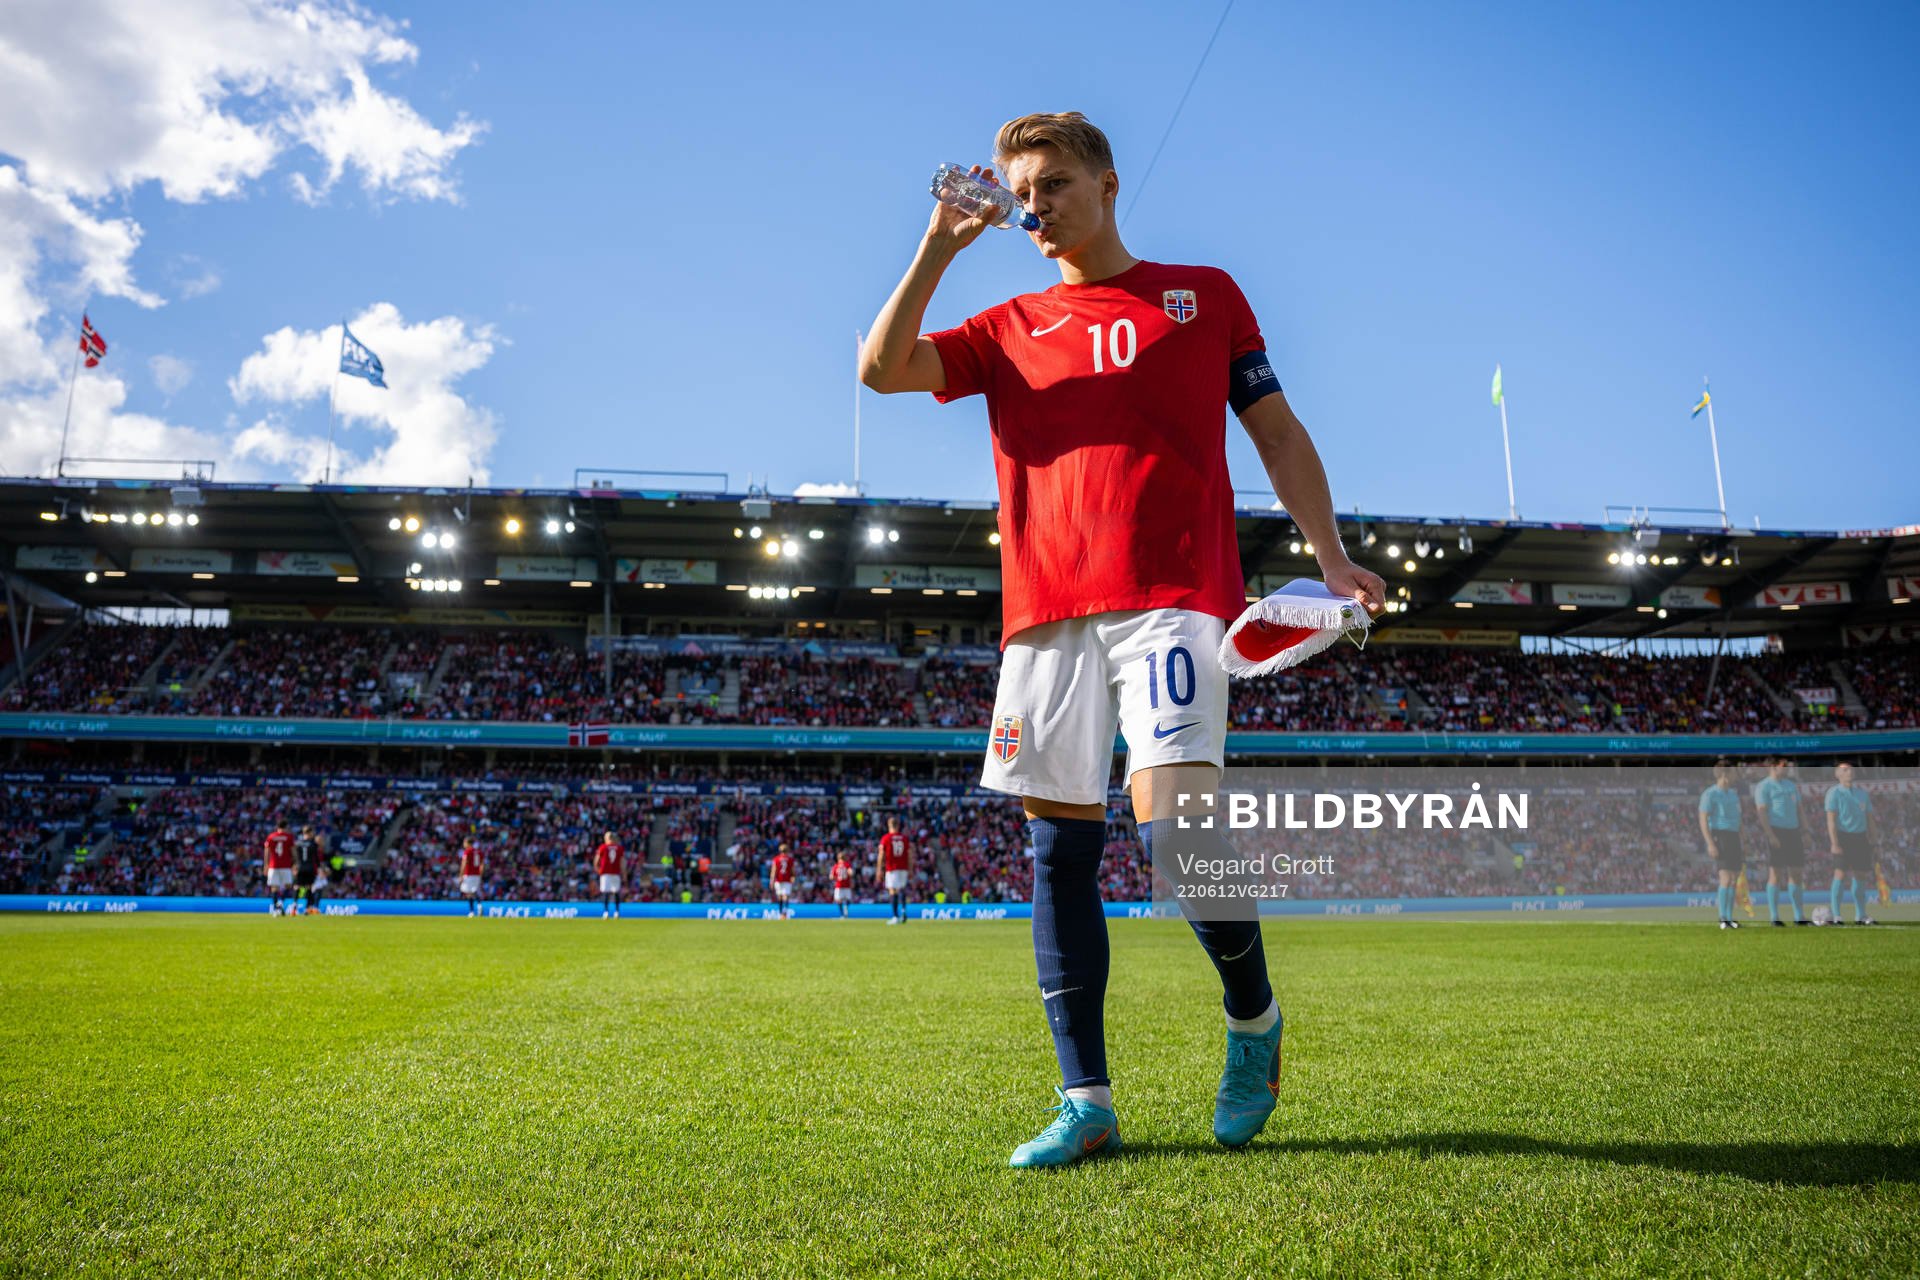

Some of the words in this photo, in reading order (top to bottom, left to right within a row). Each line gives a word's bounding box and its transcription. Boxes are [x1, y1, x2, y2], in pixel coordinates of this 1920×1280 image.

[1087, 318, 1137, 373] 10
[1770, 585, 1838, 603] VG
[1145, 646, 1196, 709] 10
